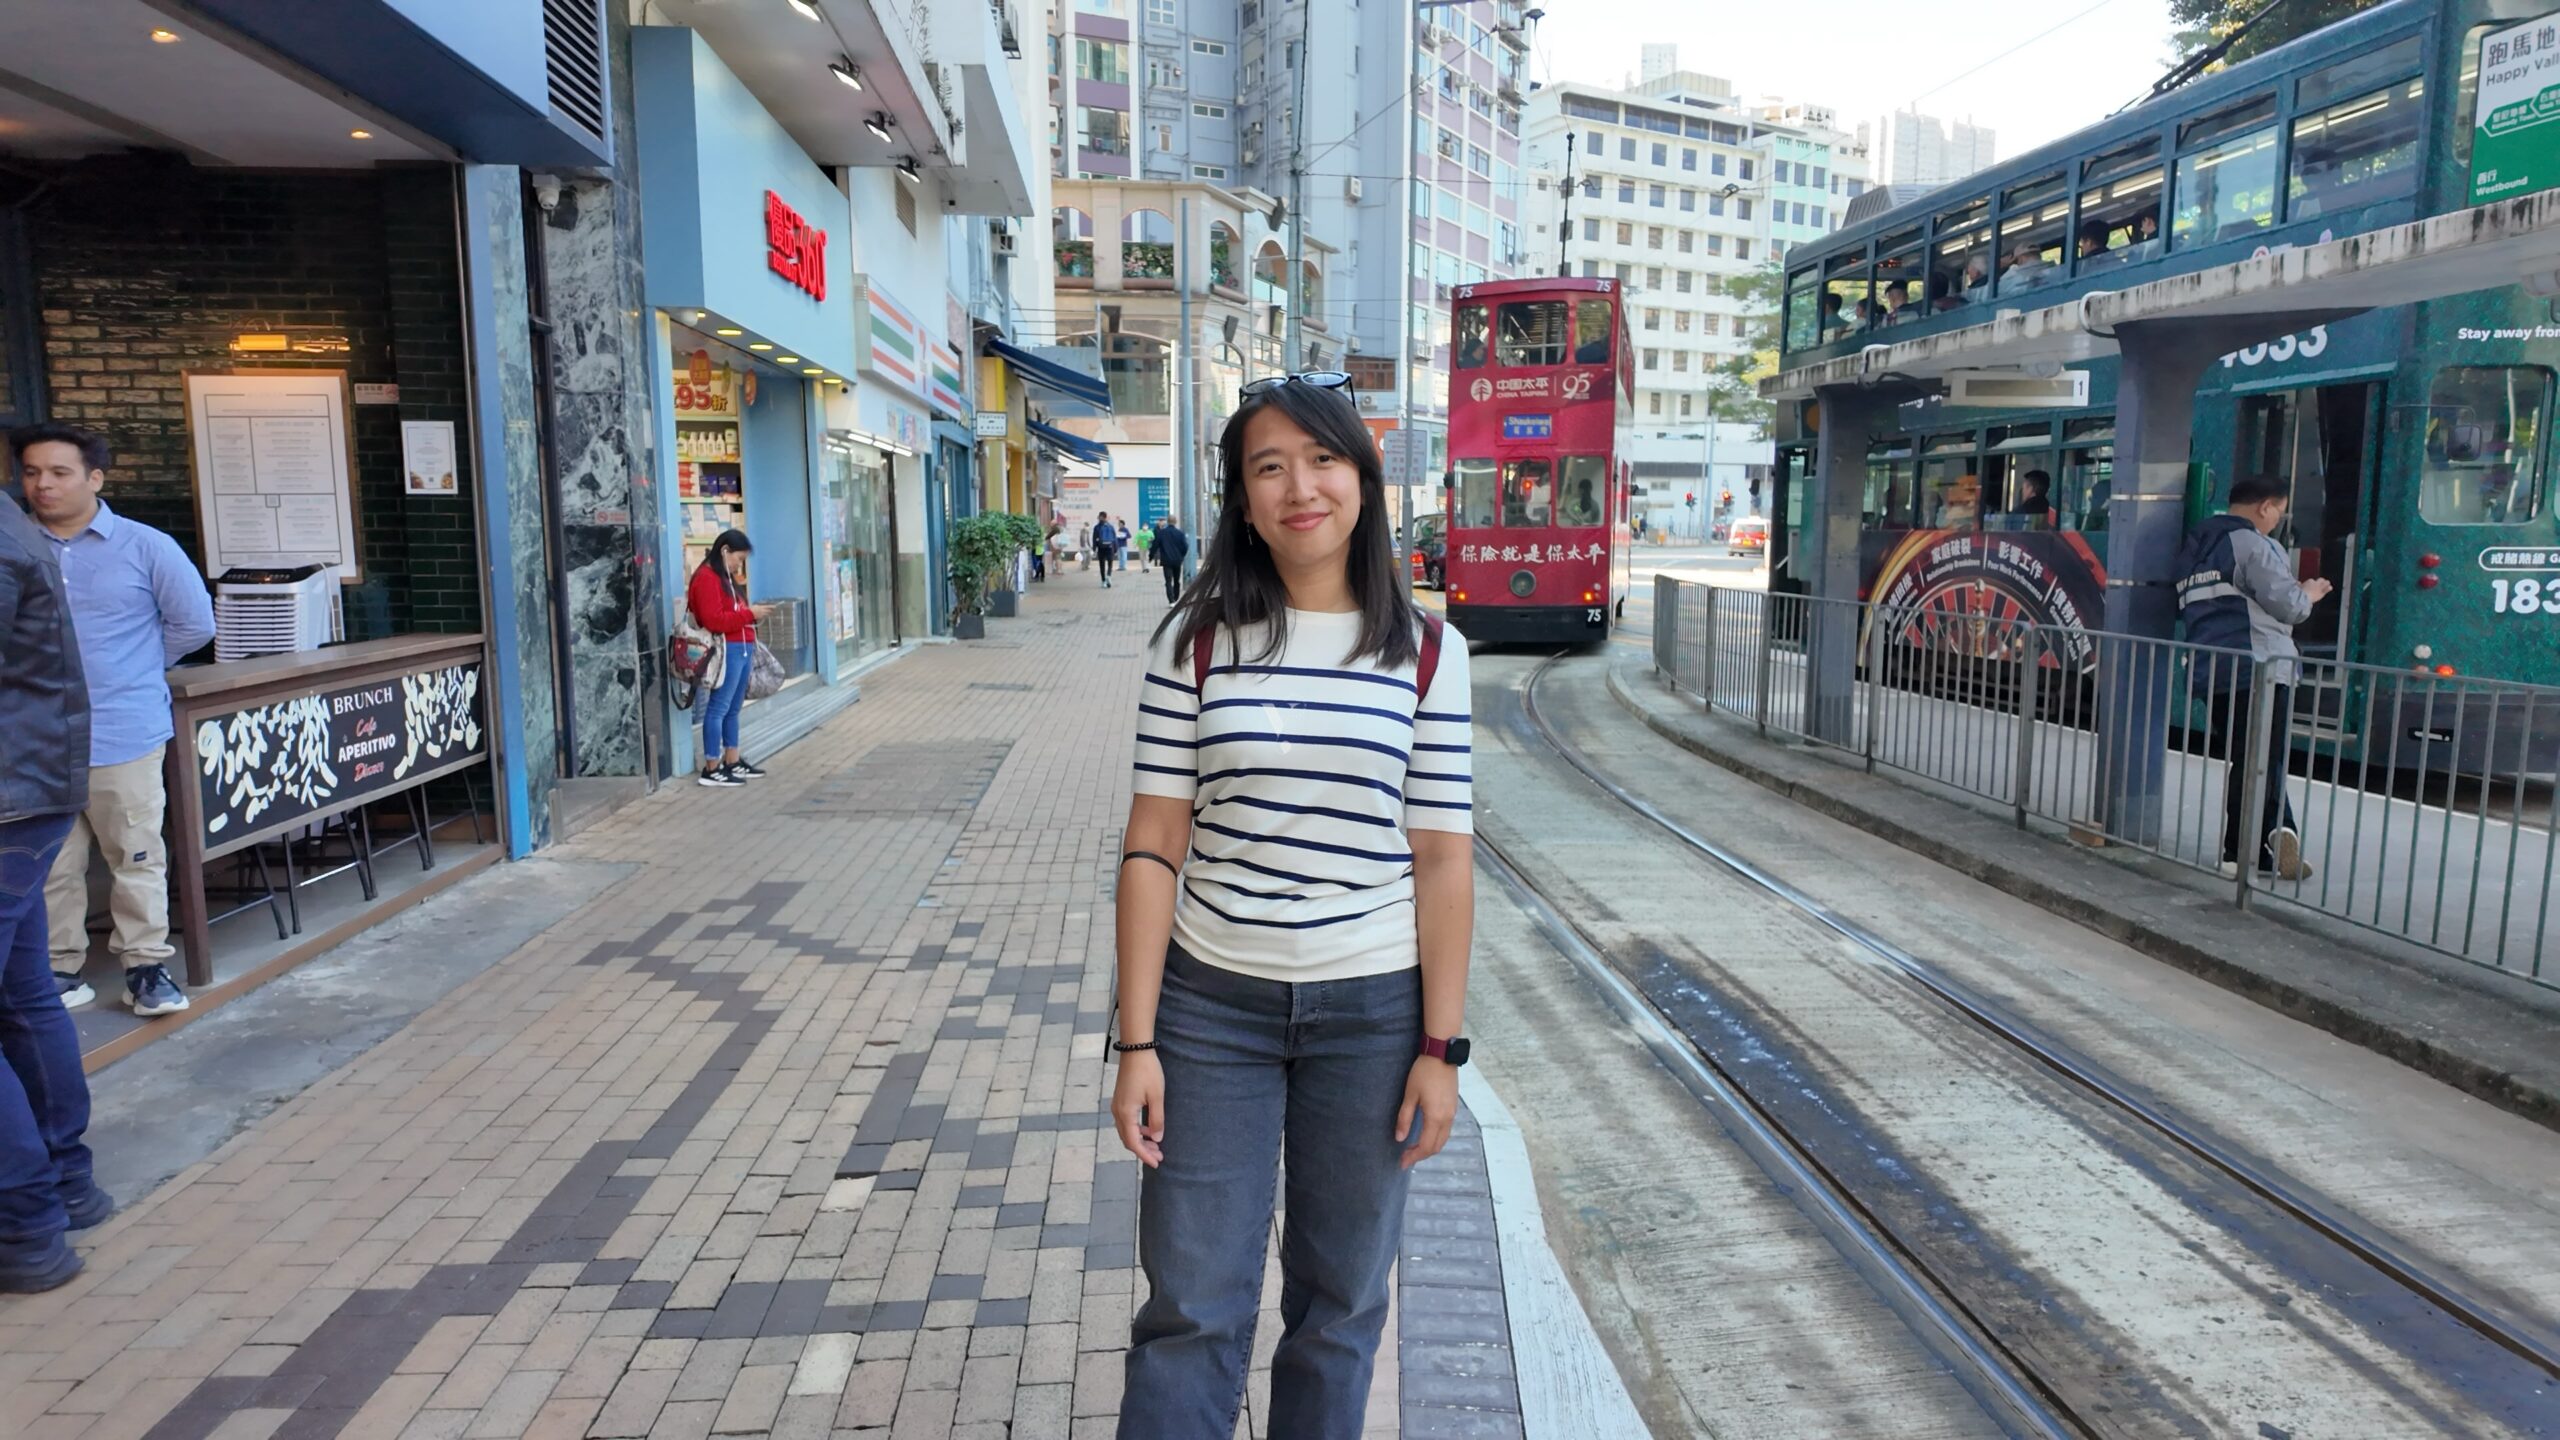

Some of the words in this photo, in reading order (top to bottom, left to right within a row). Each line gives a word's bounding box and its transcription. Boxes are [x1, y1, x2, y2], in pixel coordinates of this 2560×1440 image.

[2487, 25, 2555, 68] 跑馬地
[2486, 64, 2529, 87] Happy
[2476, 176, 2529, 197] Westbound
[2477, 169, 2498, 186] 西行
[1459, 286, 1474, 299] 75
[1596, 280, 1611, 292] 75
[2457, 327, 2491, 342] Stay
[2493, 328, 2532, 341] away
[1520, 390, 1549, 398] TAIPING
[2078, 380, 2084, 396] 1
[1460, 543, 1606, 567] 保險就是保太平
[2491, 578, 2560, 614] 183
[1587, 609, 1602, 622] 75
[333, 686, 393, 715] BRUNCH
[338, 733, 396, 763] APERITIVO
